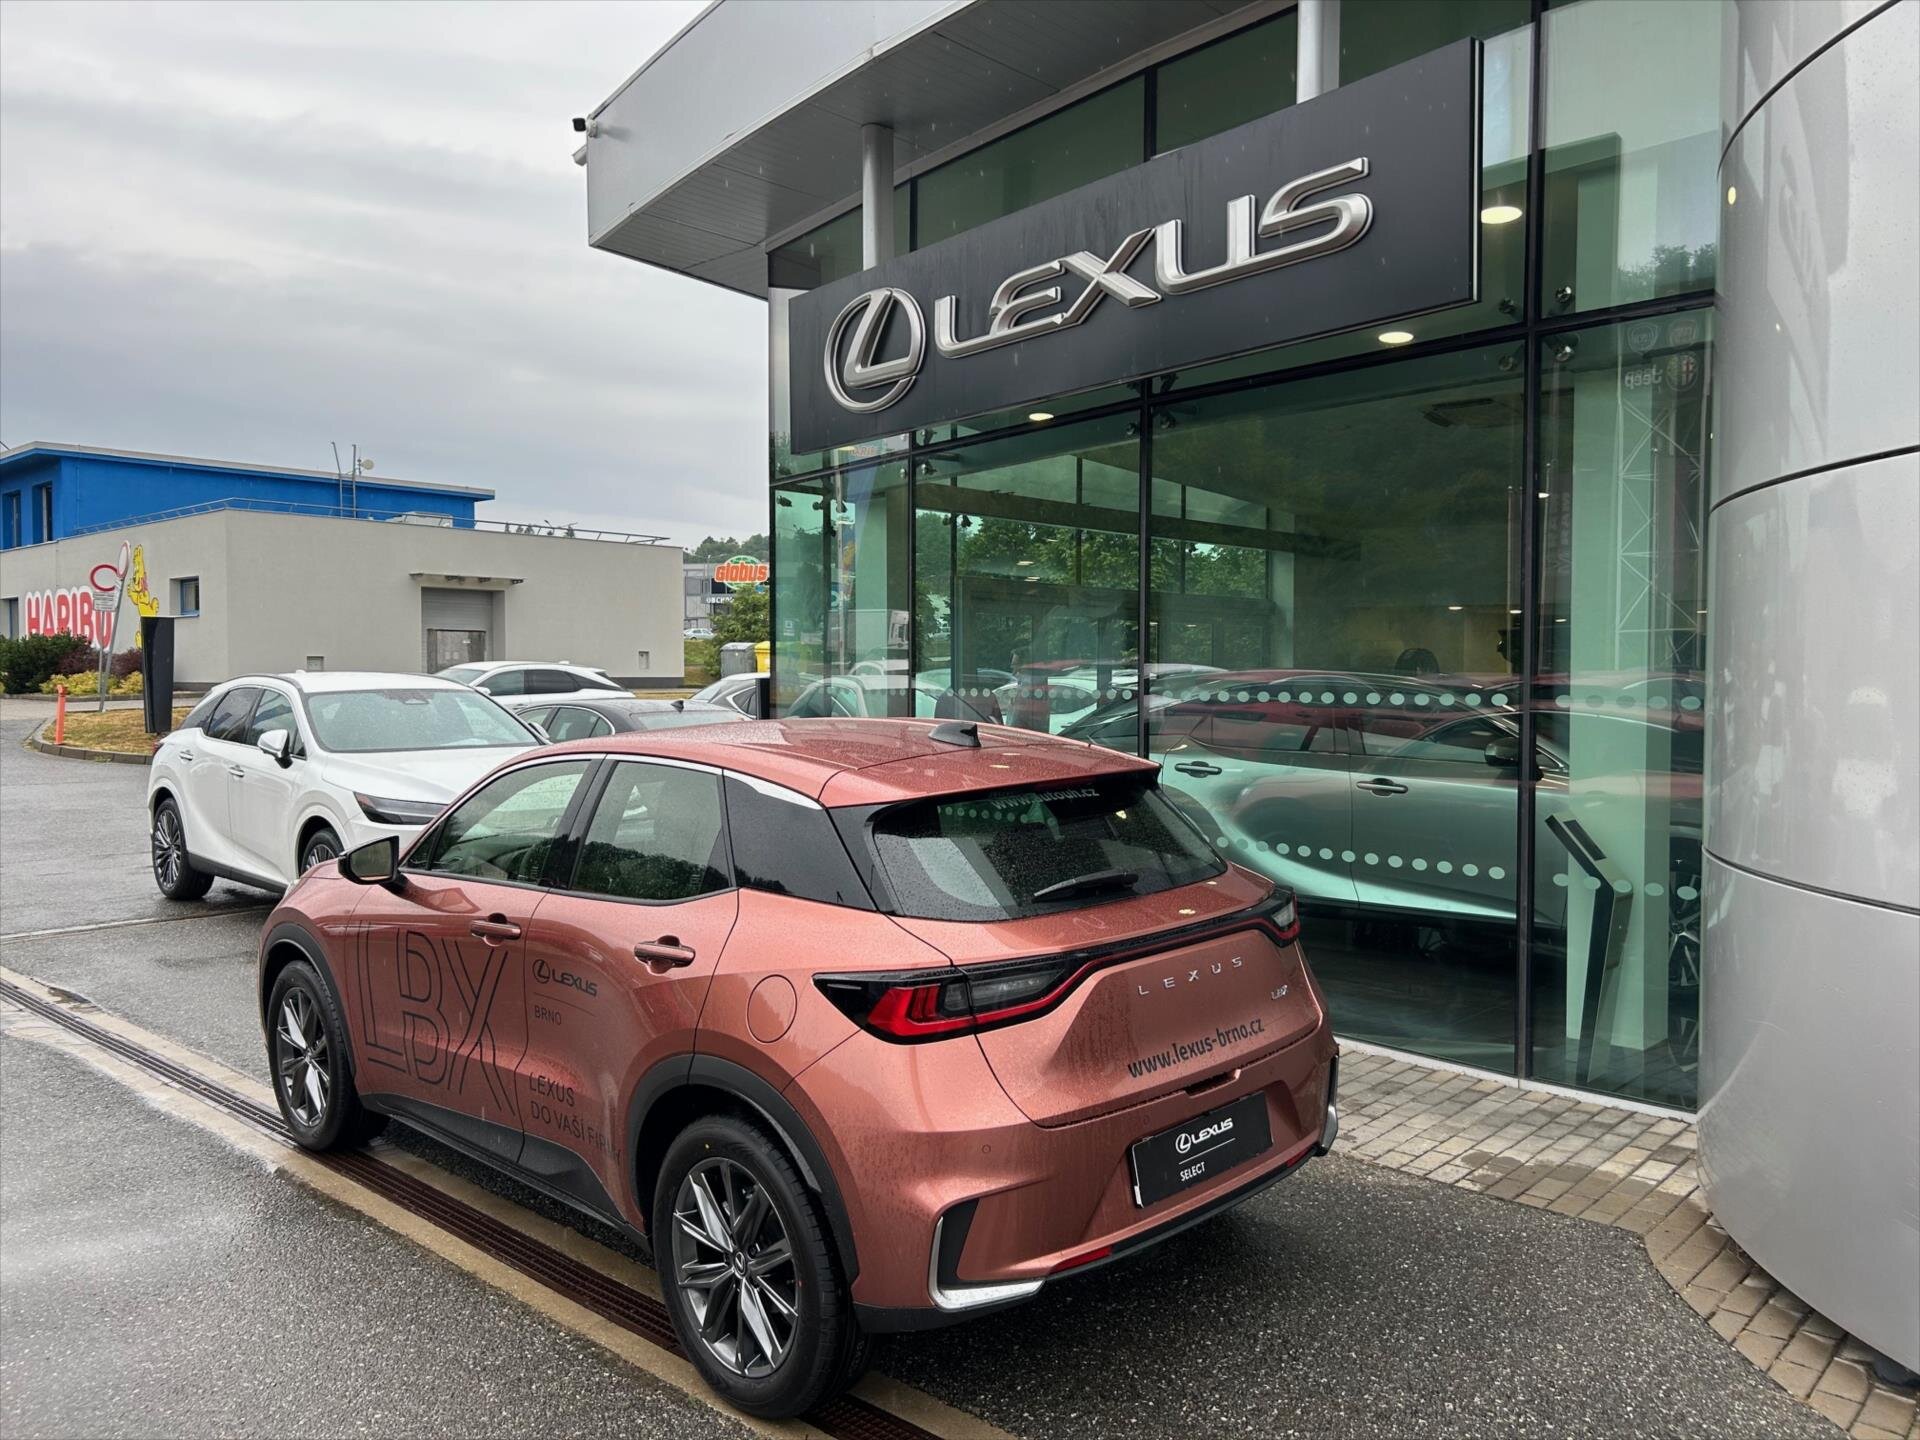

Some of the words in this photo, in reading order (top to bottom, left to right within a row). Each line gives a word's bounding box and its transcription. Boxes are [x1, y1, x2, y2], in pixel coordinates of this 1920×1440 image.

[934, 156, 1374, 359] LEXUS
[552, 968, 598, 998] LEXUS
[1138, 956, 1243, 996] LEXUS
[356, 920, 516, 1116] LBX
[534, 1005, 562, 1026] BRNO
[1128, 1018, 1265, 1078] www.lexus-brno.cz
[528, 1072, 576, 1107] LEXUS
[530, 1100, 552, 1124] DO
[553, 1109, 585, 1141] VAŠÍ
[1191, 1117, 1234, 1144] LEXUS
[1180, 1161, 1206, 1181] SELECT
